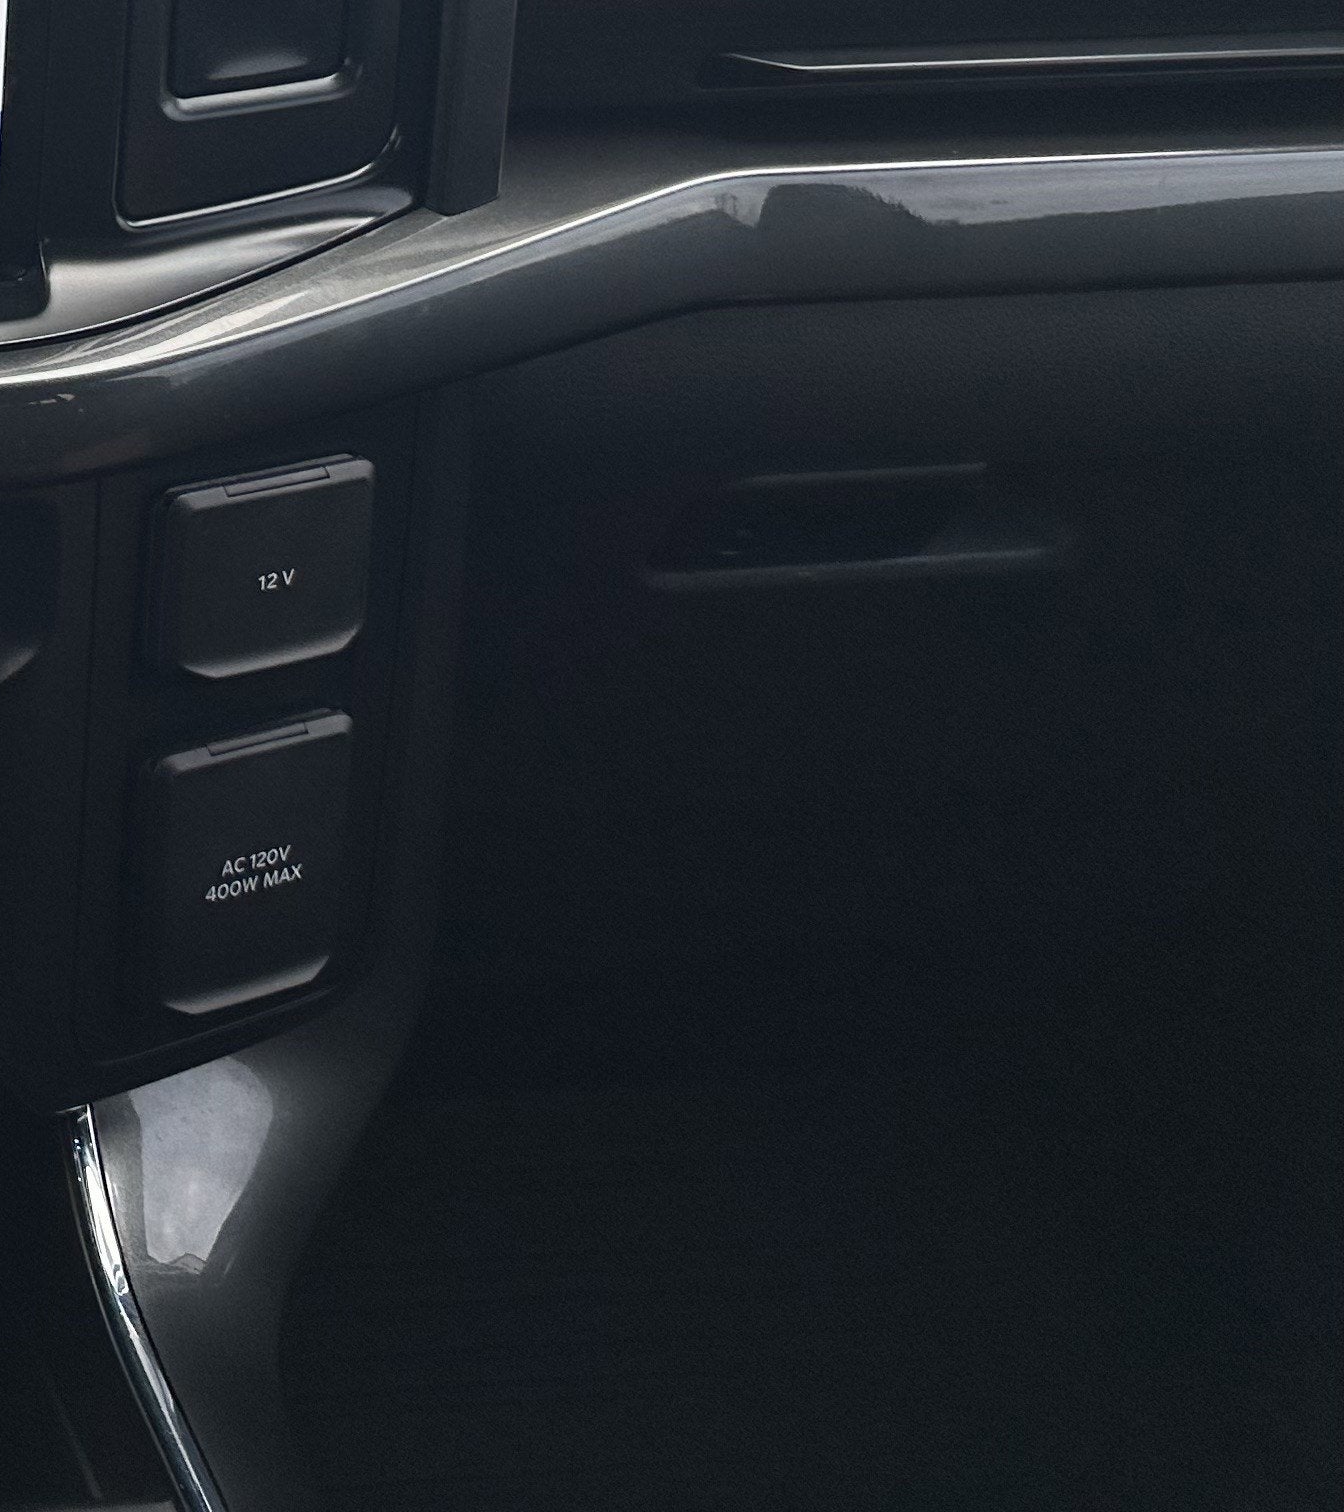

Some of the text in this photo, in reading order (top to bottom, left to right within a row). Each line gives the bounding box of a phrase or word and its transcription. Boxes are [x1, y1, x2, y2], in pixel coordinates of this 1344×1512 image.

[259, 569, 294, 590] 12 V
[222, 844, 292, 876] AC 120V
[204, 862, 304, 902] 400W MAX
